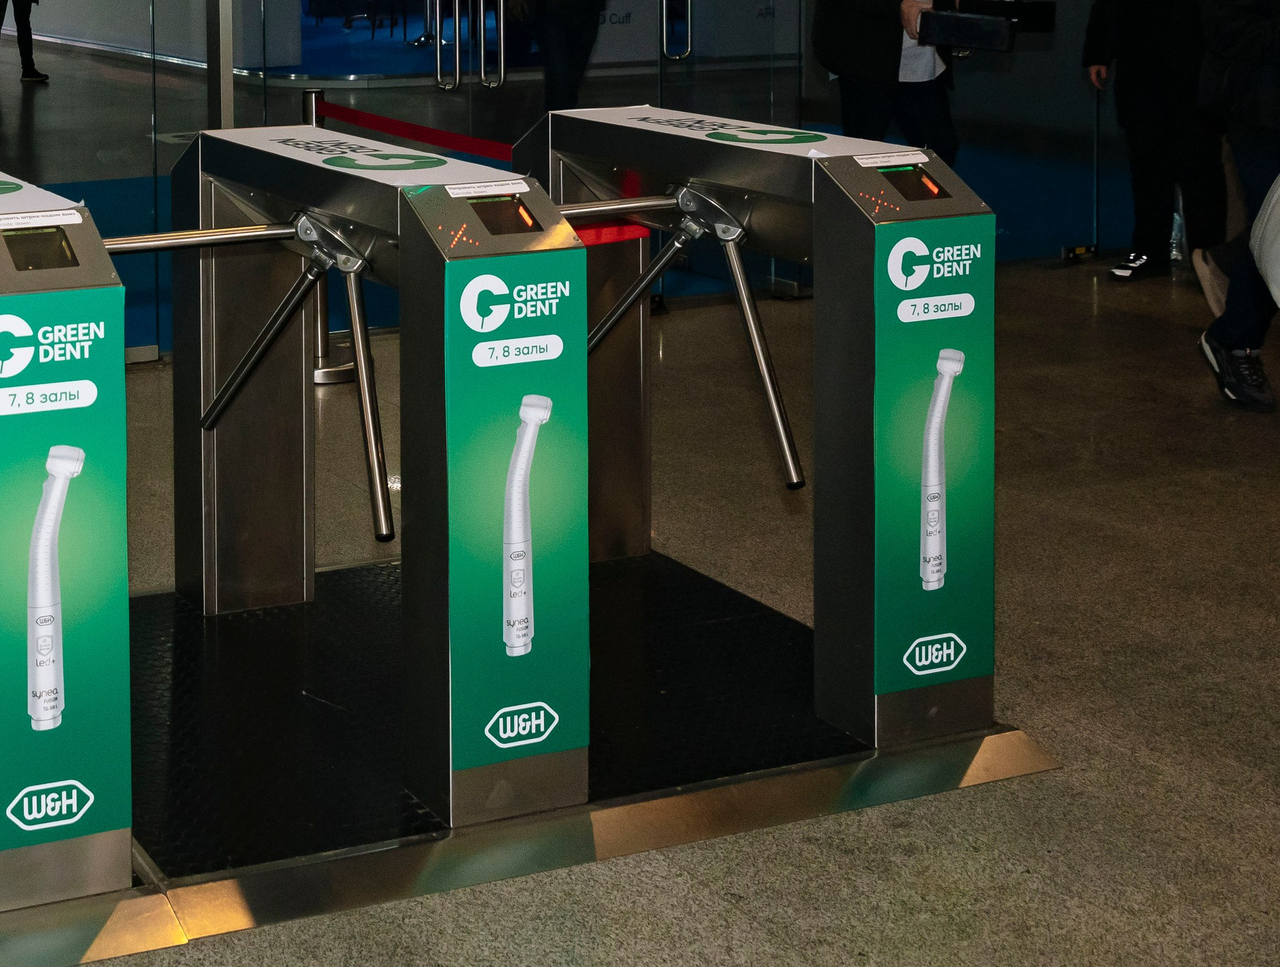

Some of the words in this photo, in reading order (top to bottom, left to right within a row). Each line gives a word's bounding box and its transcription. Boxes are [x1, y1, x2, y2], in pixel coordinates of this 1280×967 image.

[609, 12, 632, 25] Cuff
[628, 116, 718, 131] GREEN
[667, 116, 750, 130] DENT
[270, 137, 348, 155] GREEN
[310, 138, 383, 153] DENT
[932, 243, 981, 262] GREEN
[933, 260, 972, 278] DENT
[513, 281, 569, 301] GREEN
[514, 299, 559, 319] DENT
[910, 304, 920, 316] 7,
[922, 303, 930, 314] 8
[933, 301, 962, 313] залы
[37, 321, 105, 344] GREEN
[39, 341, 92, 363] DENT
[488, 347, 498, 360] 7,
[502, 345, 510, 357] 8
[514, 344, 548, 356] залы
[8, 394, 21, 408] 7,
[25, 392, 35, 405] 8
[39, 390, 80, 404] залы
[923, 554, 942, 564] synea
[506, 617, 529, 628] synea
[36, 657, 56, 667] led+
[915, 641, 955, 667] W&H
[31, 688, 58, 700] synea
[499, 710, 545, 739] W&H
[23, 788, 78, 821] W&H
